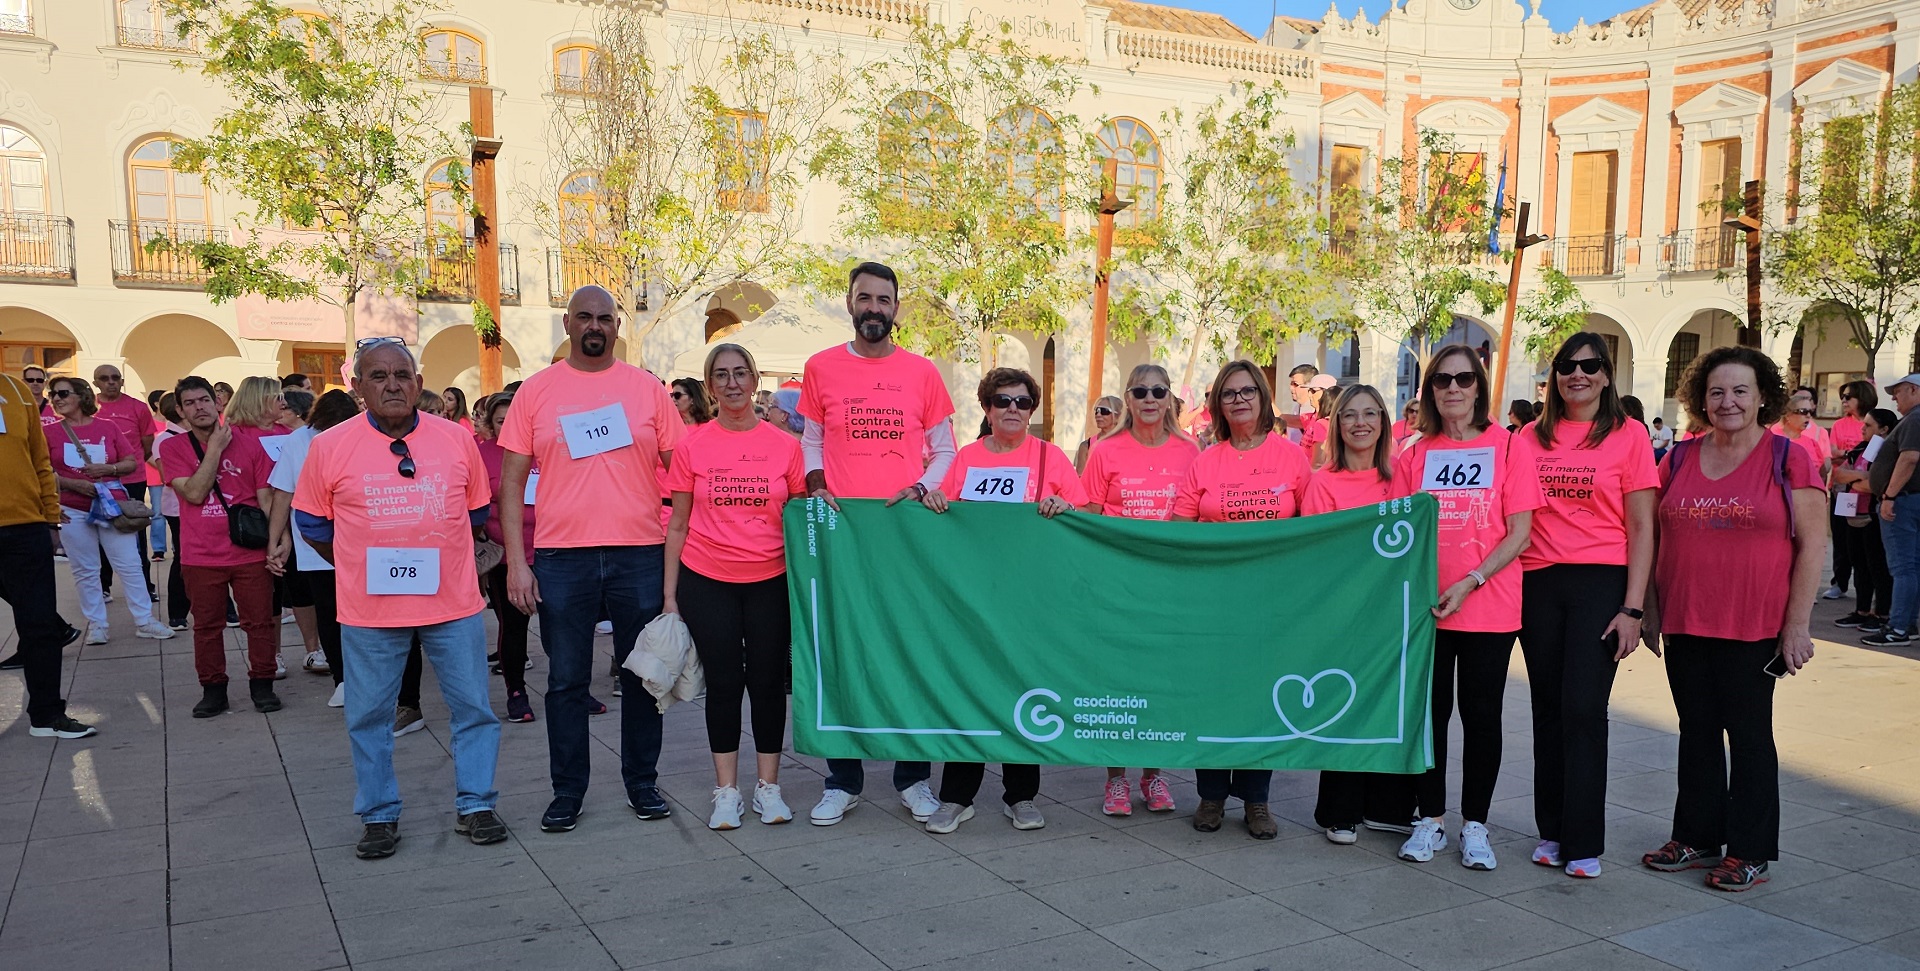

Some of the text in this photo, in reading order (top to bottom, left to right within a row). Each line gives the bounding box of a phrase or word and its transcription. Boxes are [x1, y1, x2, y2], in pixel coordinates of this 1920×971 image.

[851, 406, 904, 416] En marcha
[851, 416, 904, 427] contra el
[585, 425, 609, 439] 110
[851, 426, 905, 440] cáncer
[1539, 464, 1596, 473] En marcha
[730, 475, 769, 483] marcha
[1435, 463, 1482, 486] 462
[1539, 474, 1593, 485] contra el
[364, 486, 380, 496] En
[714, 484, 770, 494] contra el
[974, 478, 1014, 495] 478
[1121, 489, 1134, 498] En
[1242, 488, 1275, 497] march
[365, 495, 408, 506] contra
[714, 494, 770, 507] cáncer
[1122, 498, 1154, 507] contra
[1226, 496, 1280, 508] contra el
[1681, 496, 1739, 508] I WALK
[367, 505, 424, 516] el cáncer
[817, 496, 826, 523] añola
[1121, 507, 1167, 516] el cáncer
[1227, 508, 1281, 520] cáncer
[1438, 510, 1470, 520] áncer
[806, 497, 817, 557] tra el cáncer
[389, 567, 417, 578] 078
[1073, 695, 1148, 709] asociación
[1073, 711, 1137, 727] española
[1073, 727, 1187, 741] contra el cáncer
